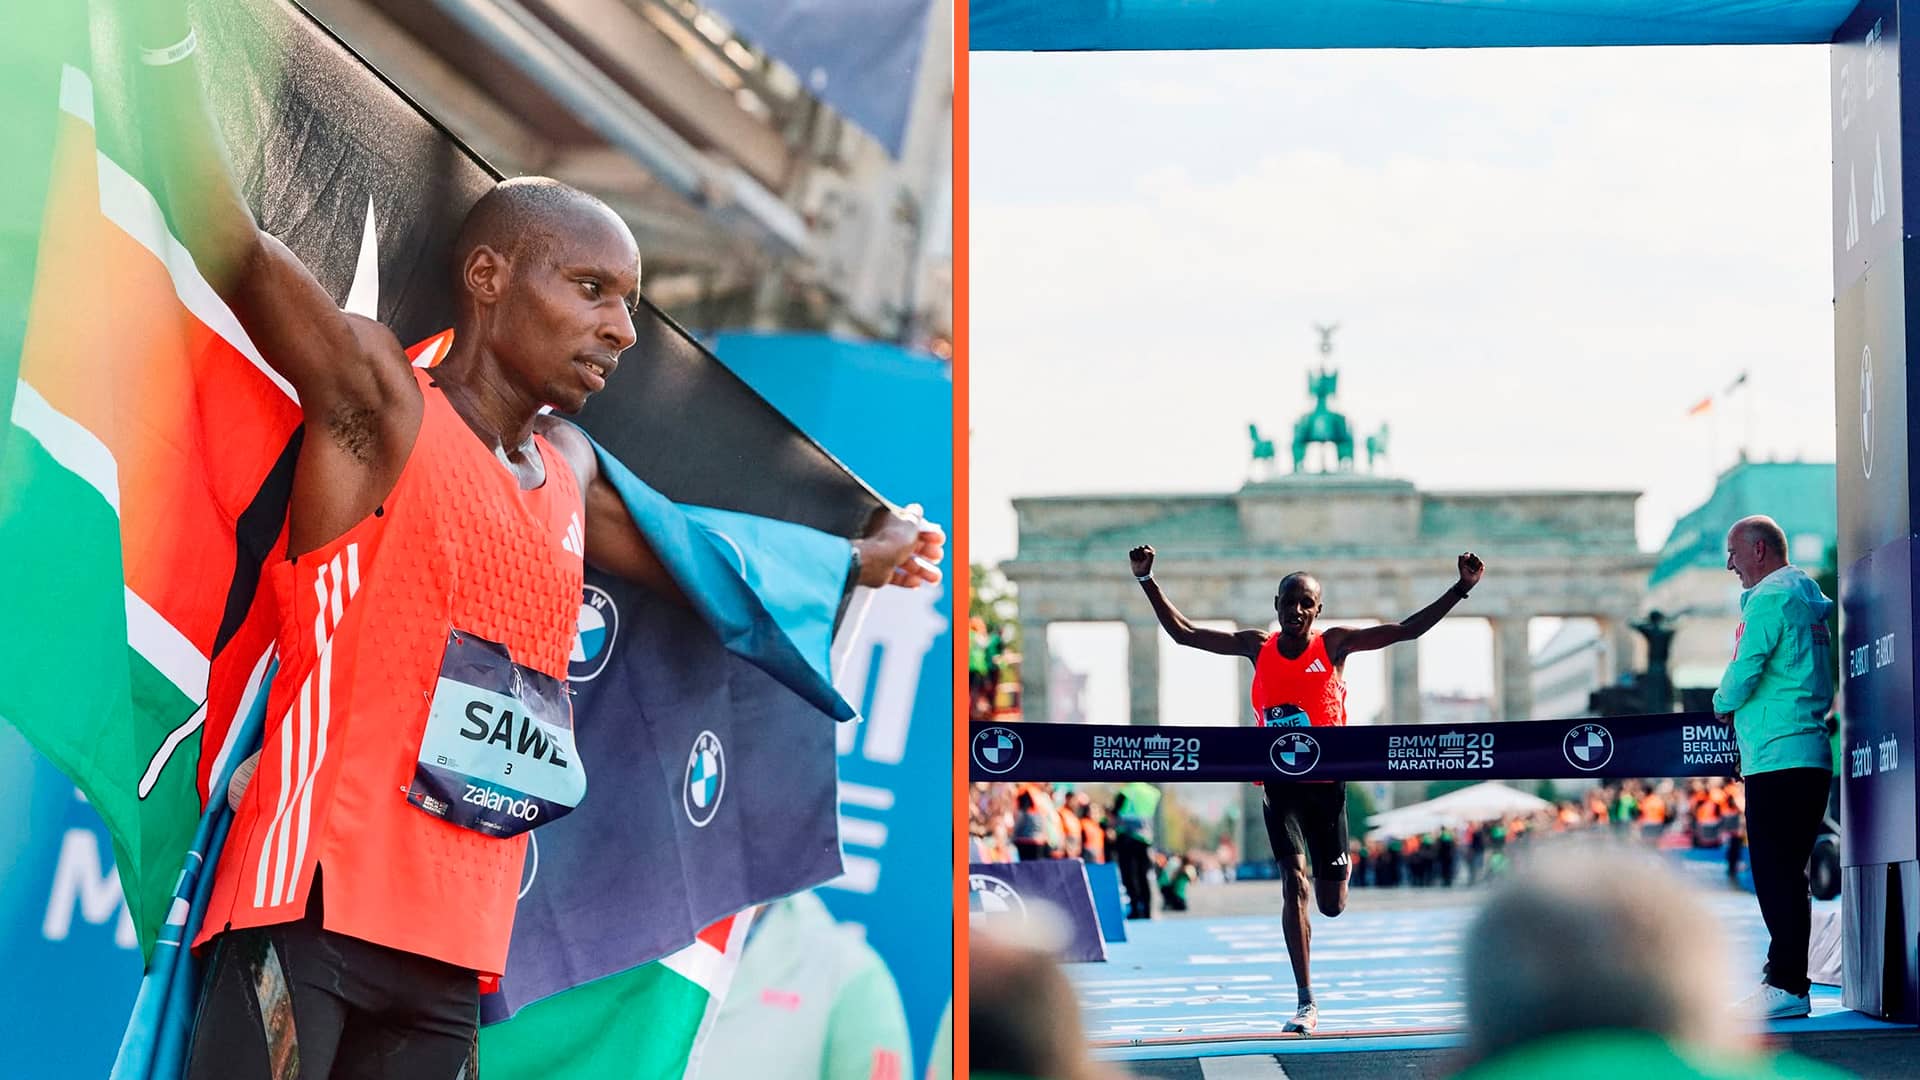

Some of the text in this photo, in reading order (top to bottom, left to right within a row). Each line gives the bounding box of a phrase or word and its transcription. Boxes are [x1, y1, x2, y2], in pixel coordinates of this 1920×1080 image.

[460, 700, 568, 768] SAWE
[979, 728, 1017, 740] BMW
[1570, 726, 1607, 738] BMW
[1682, 725, 1729, 741] BMW
[1094, 736, 1141, 748] BMW
[1172, 738, 1200, 752] 20
[1277, 735, 1314, 747] BMW
[1389, 735, 1436, 748] BMW
[1467, 733, 1494, 748] 20
[1388, 748, 1436, 758] BERLIN
[1683, 742, 1731, 752] BERLIN
[1093, 749, 1141, 758] BERLIN
[1466, 751, 1494, 768] 25
[1093, 760, 1170, 771] MARATHON
[1172, 754, 1200, 771] 25
[1388, 759, 1464, 770] MARATHON
[504, 763, 513, 775] 3
[462, 784, 539, 821] zalando
